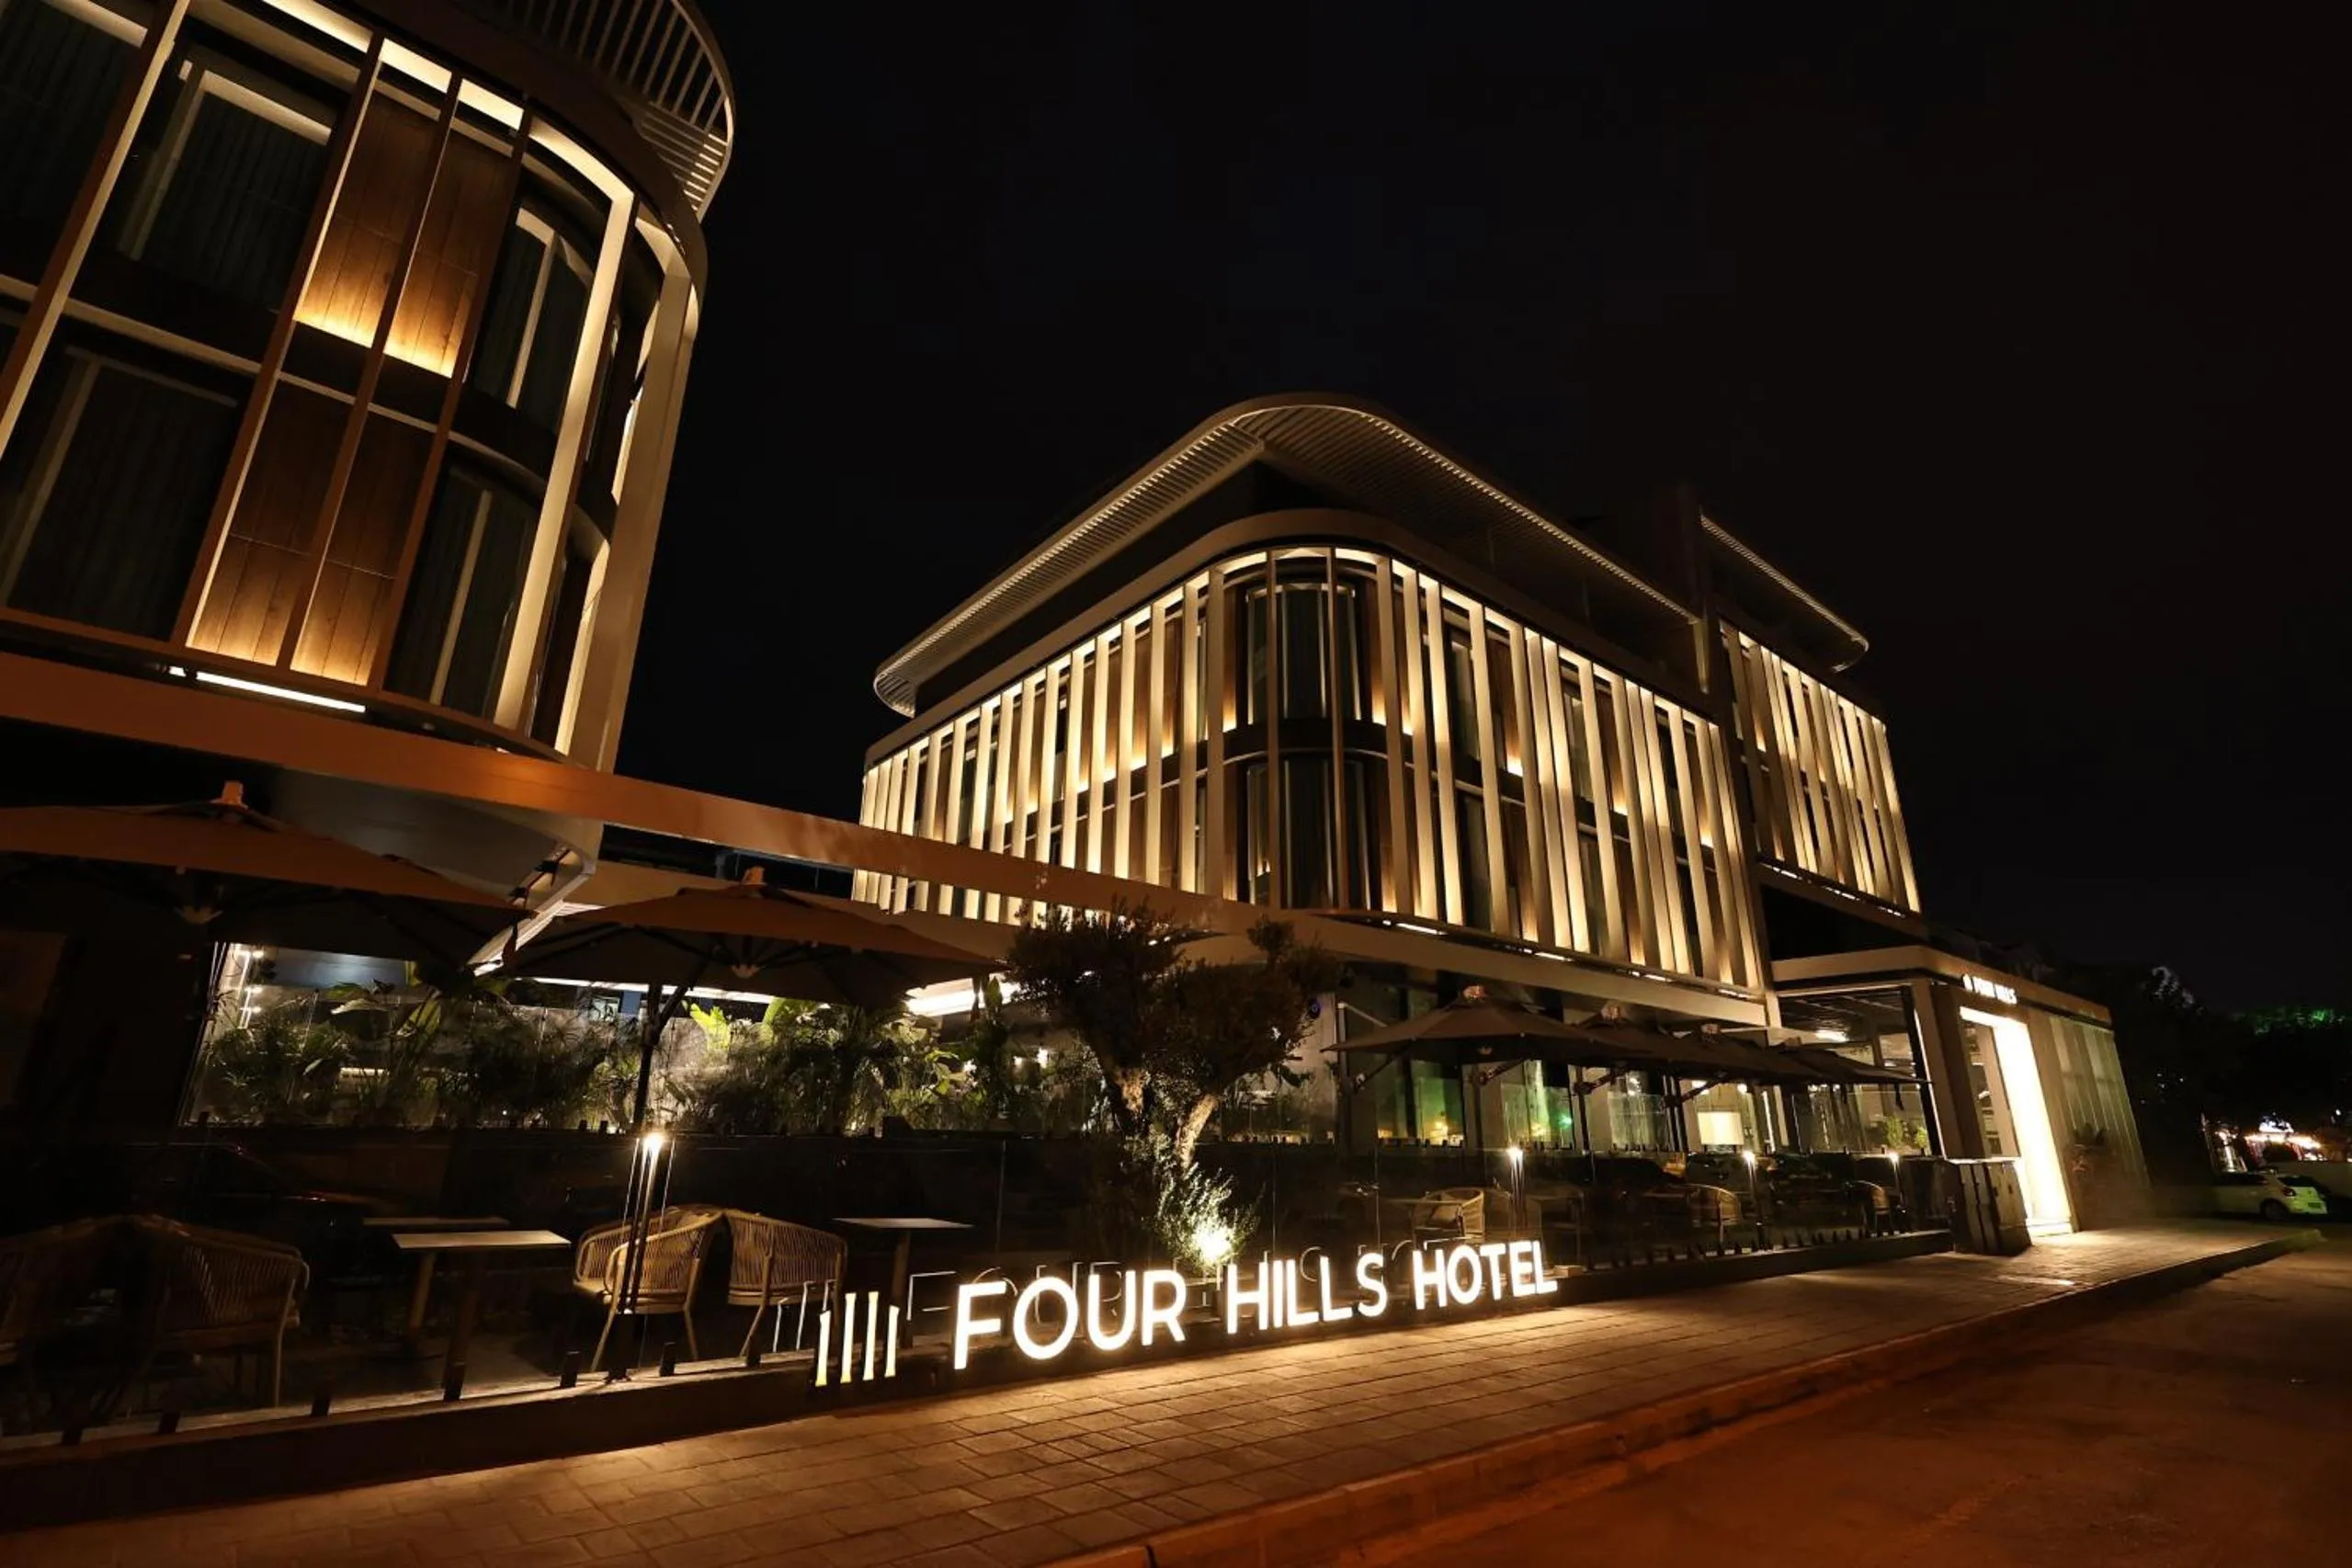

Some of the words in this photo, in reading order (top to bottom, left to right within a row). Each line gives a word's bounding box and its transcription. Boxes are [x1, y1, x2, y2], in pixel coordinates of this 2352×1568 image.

[954, 1269, 1187, 1369] FOUR
[1226, 1252, 1387, 1334] HILLS
[1412, 1240, 1558, 1310] HOTEL
